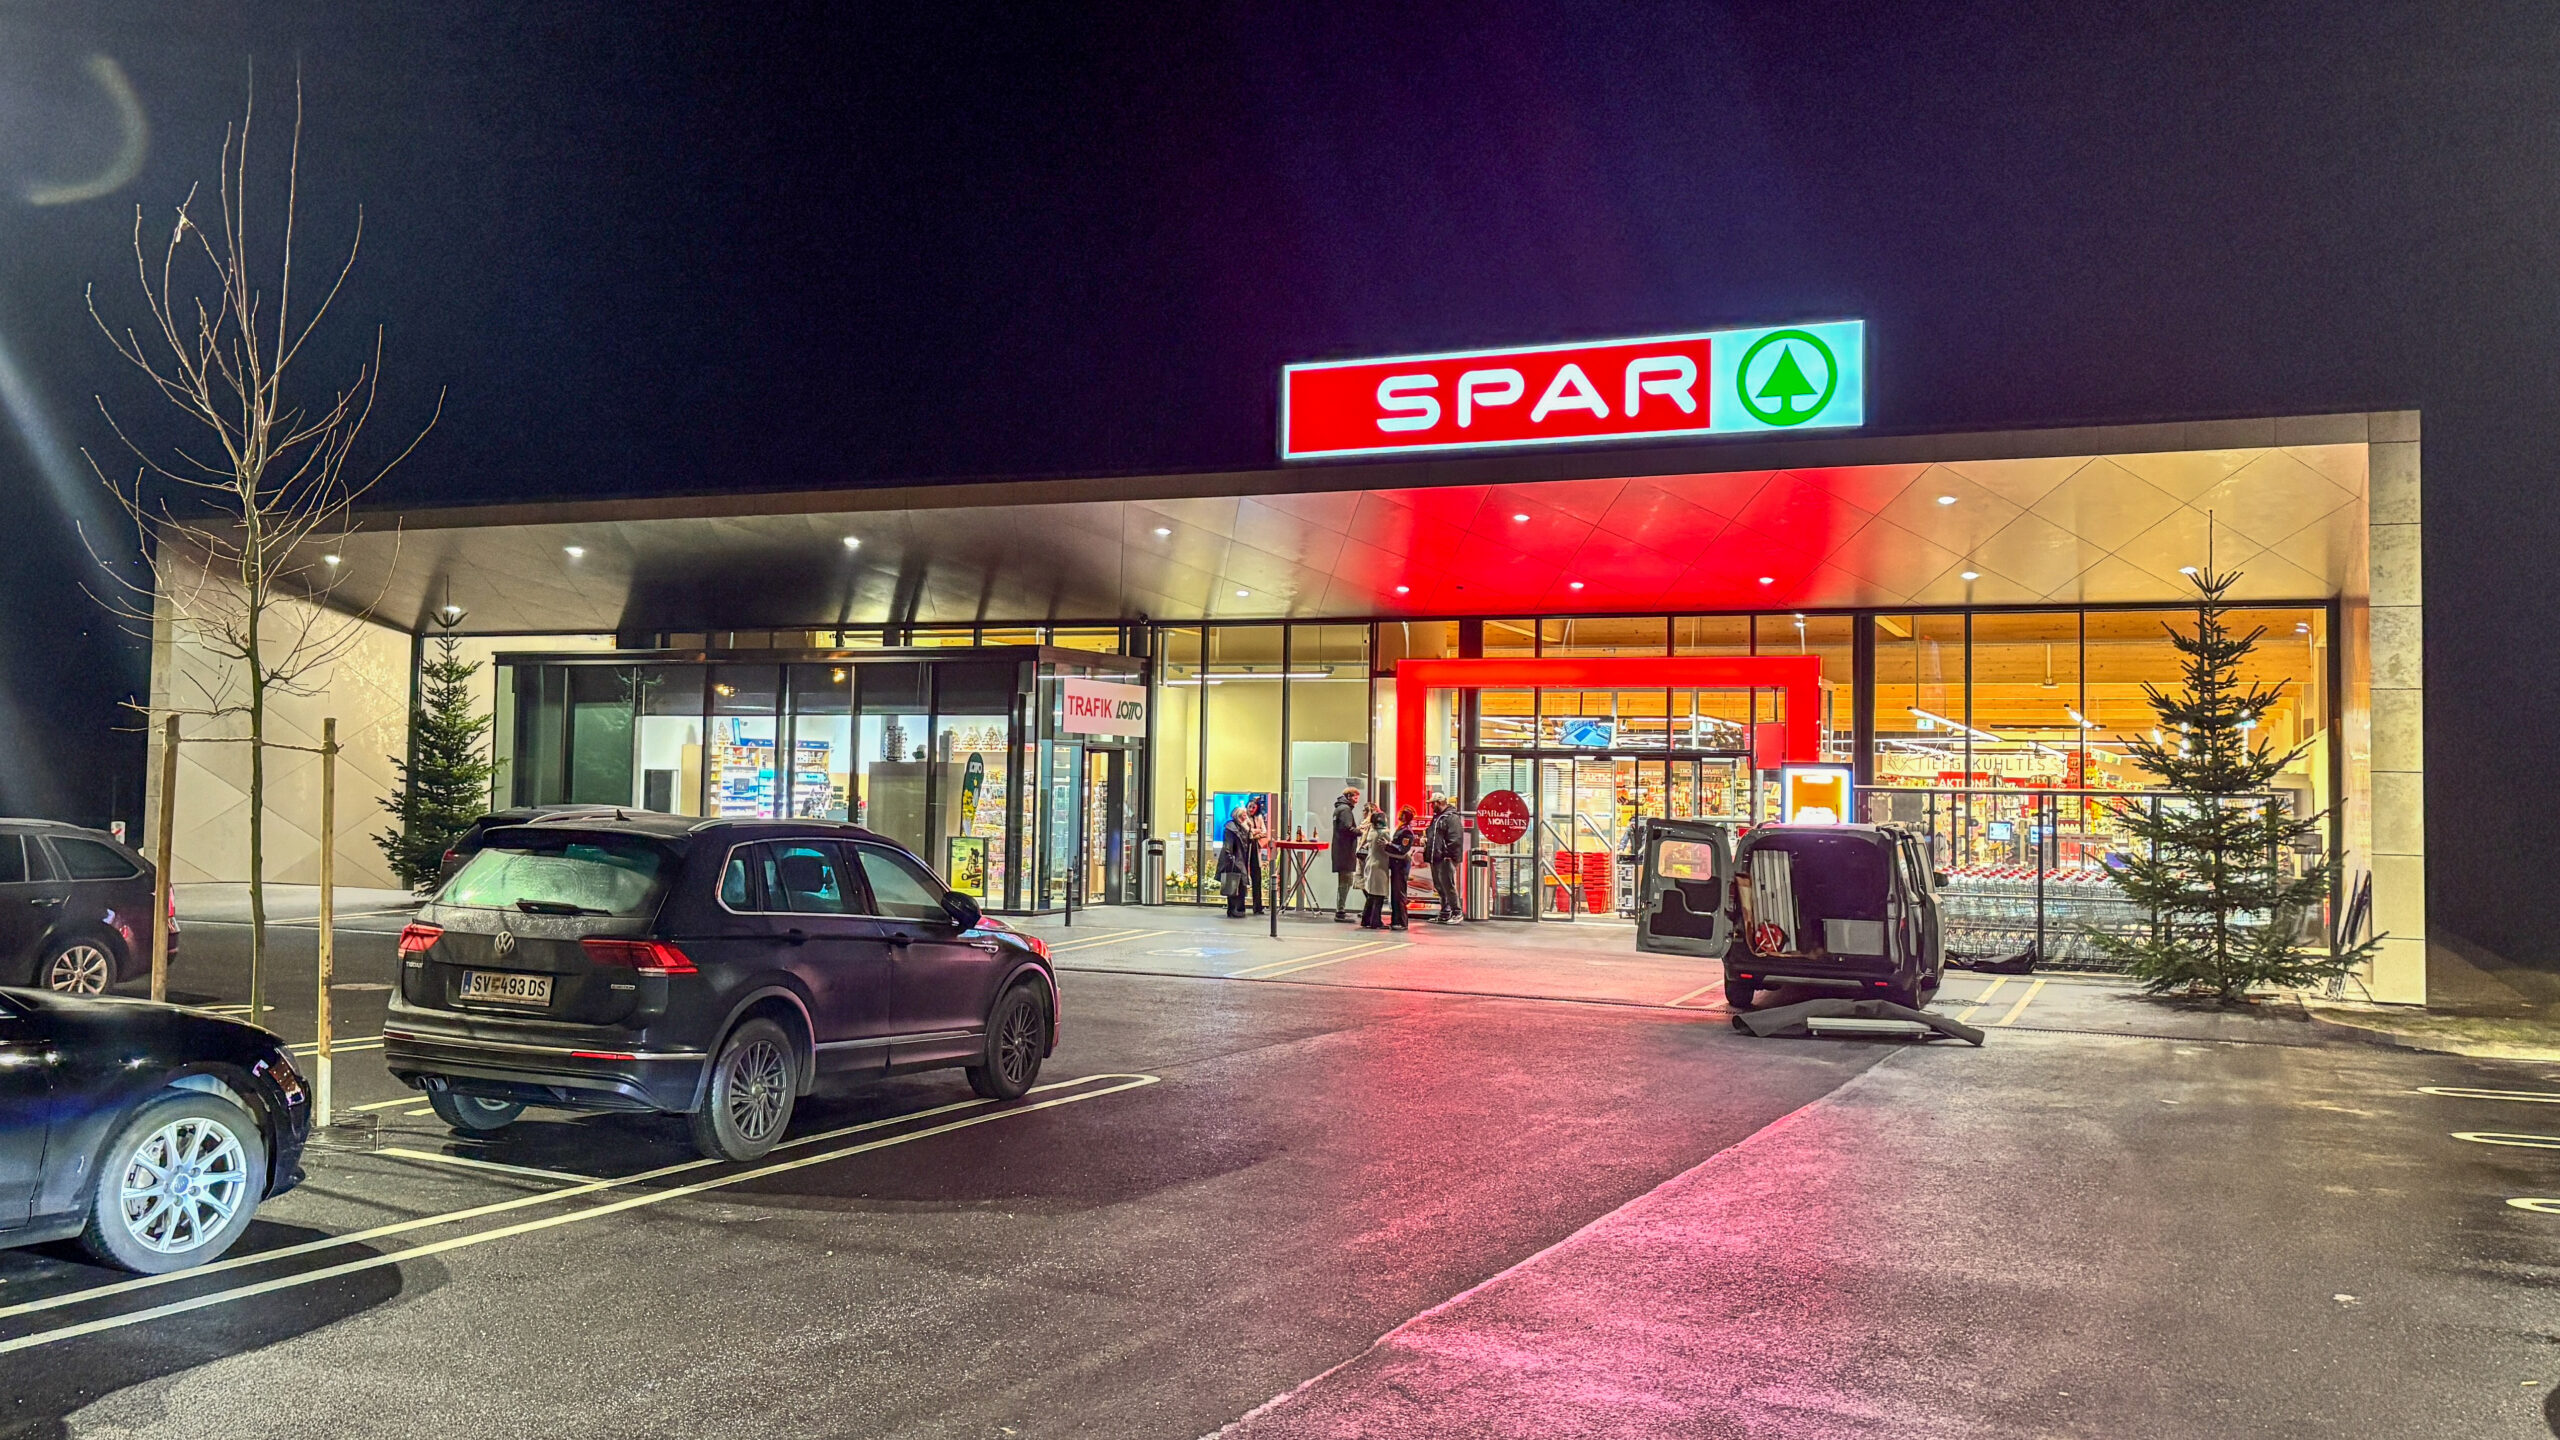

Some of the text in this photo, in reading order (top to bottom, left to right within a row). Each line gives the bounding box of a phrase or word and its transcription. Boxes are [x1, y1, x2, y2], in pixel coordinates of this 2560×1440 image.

[1377, 355, 1698, 431] SPAR
[1068, 695, 1143, 720] TRAFIK LOTTO
[1488, 818, 1527, 826] MOMENTS
[473, 975, 546, 997] SV 493 DS
